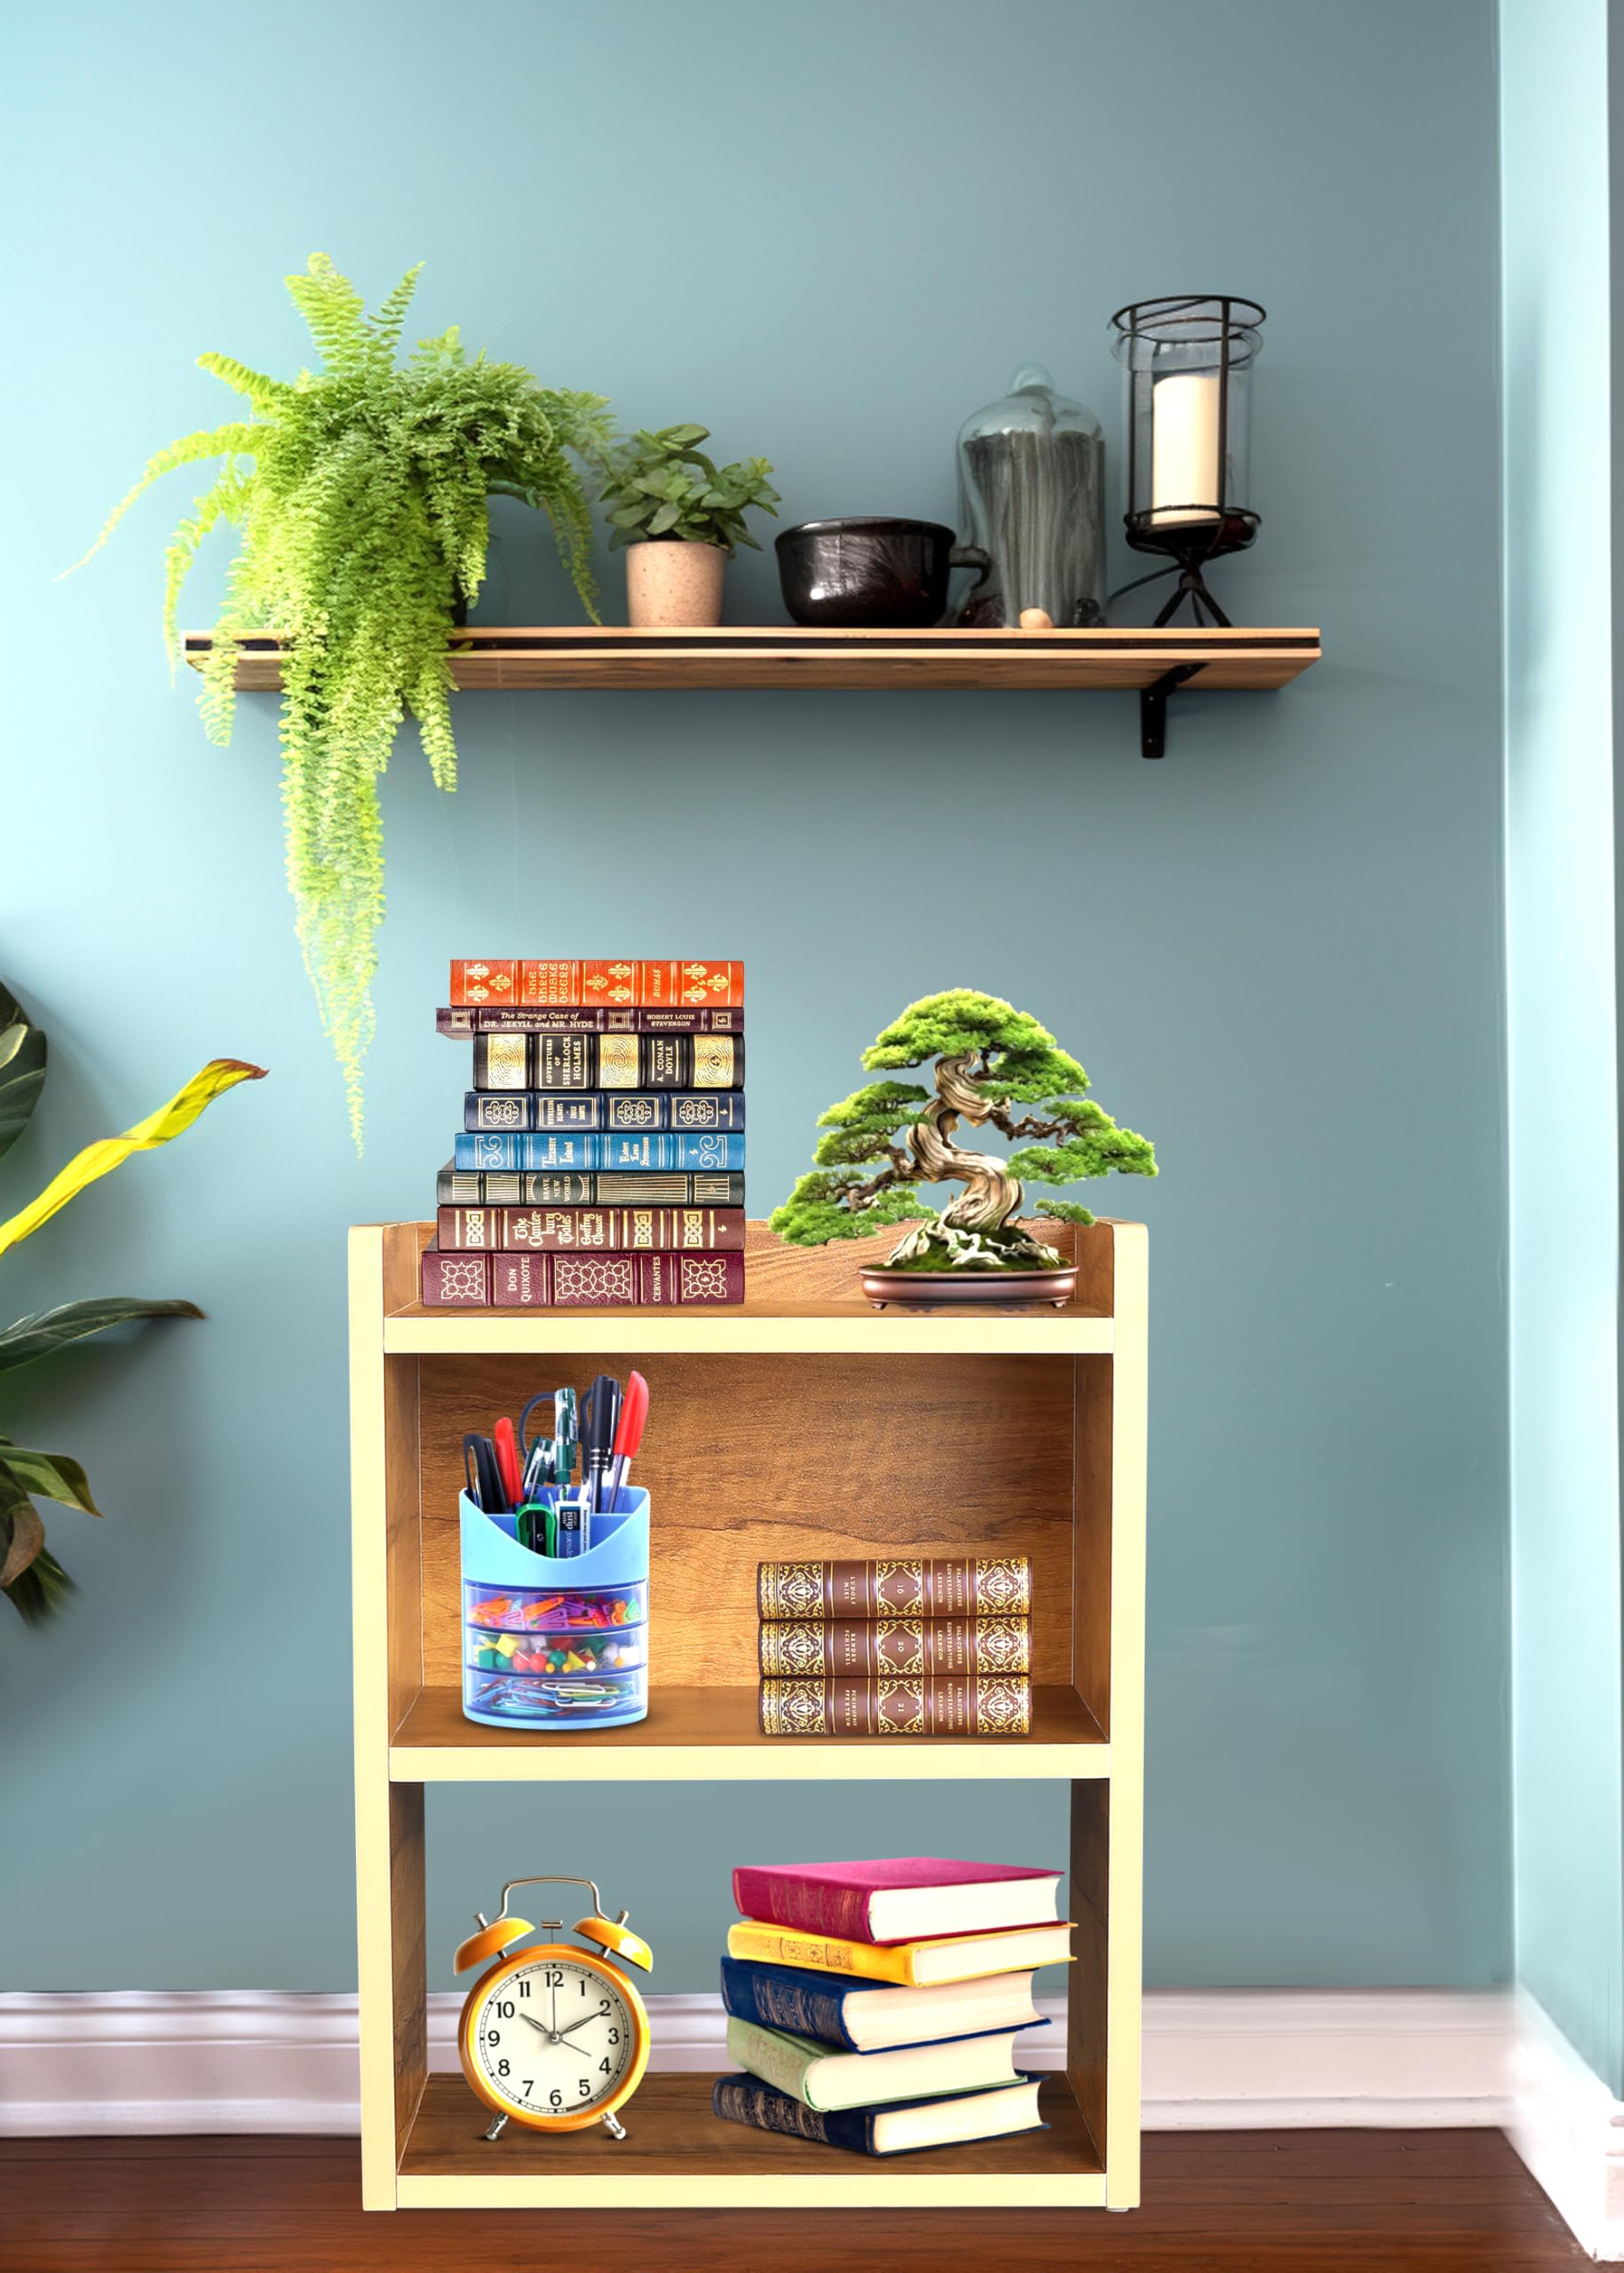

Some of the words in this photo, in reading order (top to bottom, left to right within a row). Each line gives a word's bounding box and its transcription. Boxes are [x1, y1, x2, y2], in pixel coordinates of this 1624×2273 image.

[538, 962, 547, 1003] THREE
[549, 963, 558, 1003] MUSKE
[559, 963, 568, 1003] TEERS
[517, 1012, 547, 1021] Strange
[554, 1056, 561, 1066] OF
[657, 1073, 664, 1082] A.
[543, 1136, 557, 1168] Treasure
[559, 1142, 574, 1165] Island
[513, 1217, 530, 1240] The
[542, 1213, 561, 1235] bury
[556, 1215, 574, 1245] Tales
[580, 1213, 595, 1246] Geoffrey
[591, 1213, 606, 1246] Chaucer
[508, 1268, 517, 1291] DON
[520, 1256, 530, 1303] QUIXOTE
[565, 1511, 574, 1530] dust
[897, 1584, 905, 1595] 16
[898, 1641, 904, 1652] 20
[898, 1703, 904, 1712] 21
[545, 1971, 564, 1987] 12
[578, 1980, 585, 1996] 1
[519, 1981, 531, 1998] 11
[495, 2001, 515, 2019] 10
[599, 2000, 611, 2016] 2
[487, 2030, 500, 2047] 9
[608, 2027, 619, 2045] 3
[498, 2059, 510, 2076] 8
[599, 2056, 612, 2074] 4
[522, 2080, 535, 2097] 7
[579, 2079, 590, 2096] 5
[550, 2089, 561, 2106] 6
